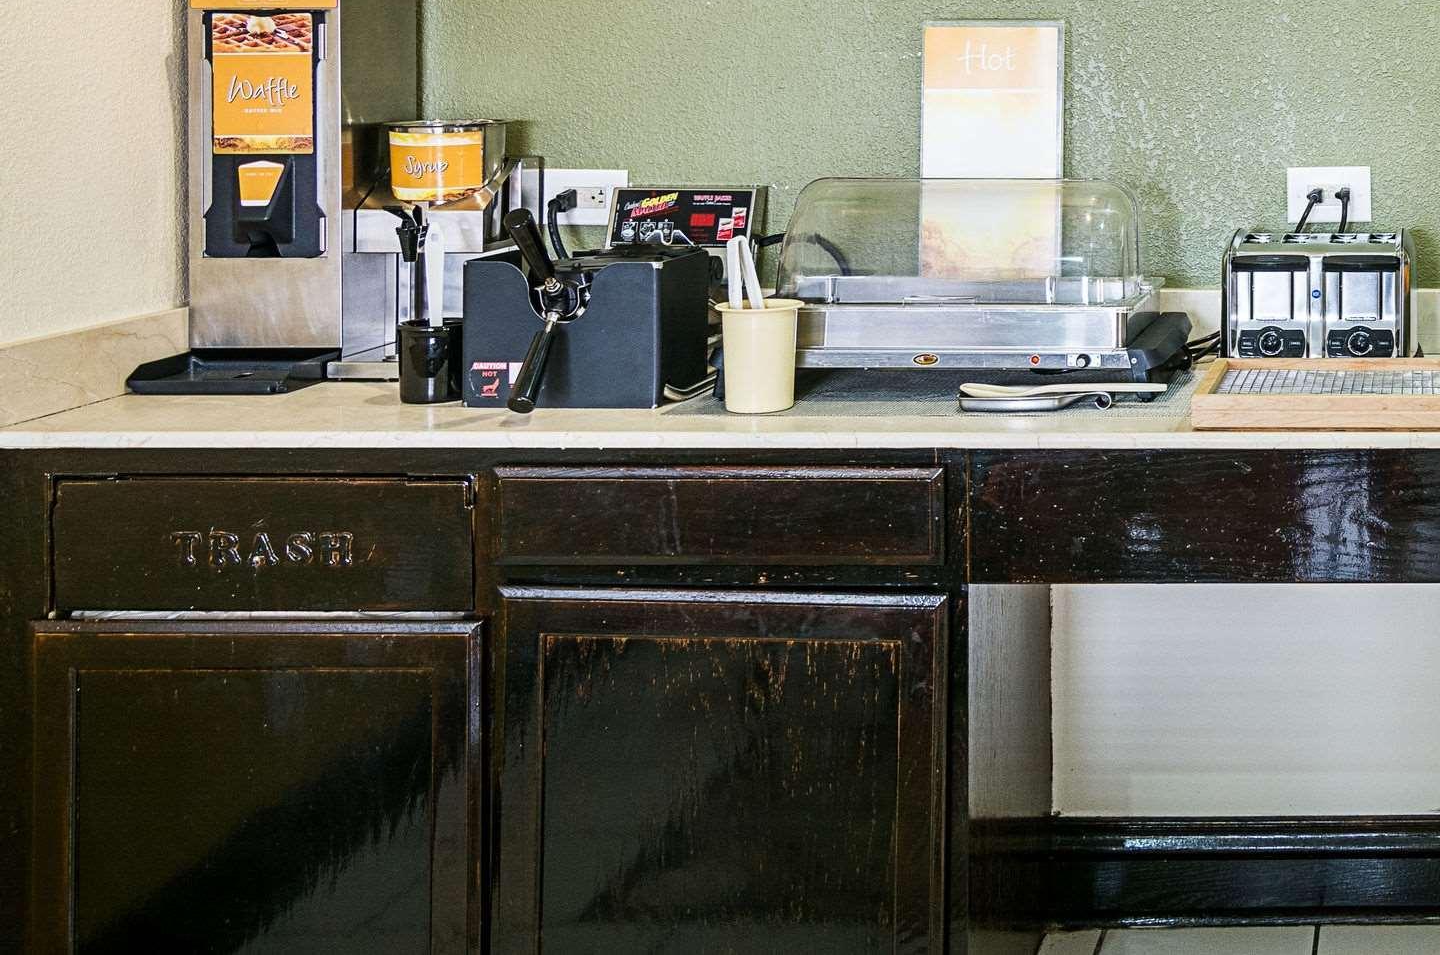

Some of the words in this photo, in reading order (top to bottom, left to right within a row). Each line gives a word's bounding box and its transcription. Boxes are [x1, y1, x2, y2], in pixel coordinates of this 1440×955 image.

[955, 38, 1016, 75] Hot
[225, 74, 300, 107] Waffle
[405, 155, 449, 179] Syrup
[641, 192, 679, 208] GOLDEN
[472, 361, 507, 370] CAUTION
[170, 529, 354, 567] TRASH
